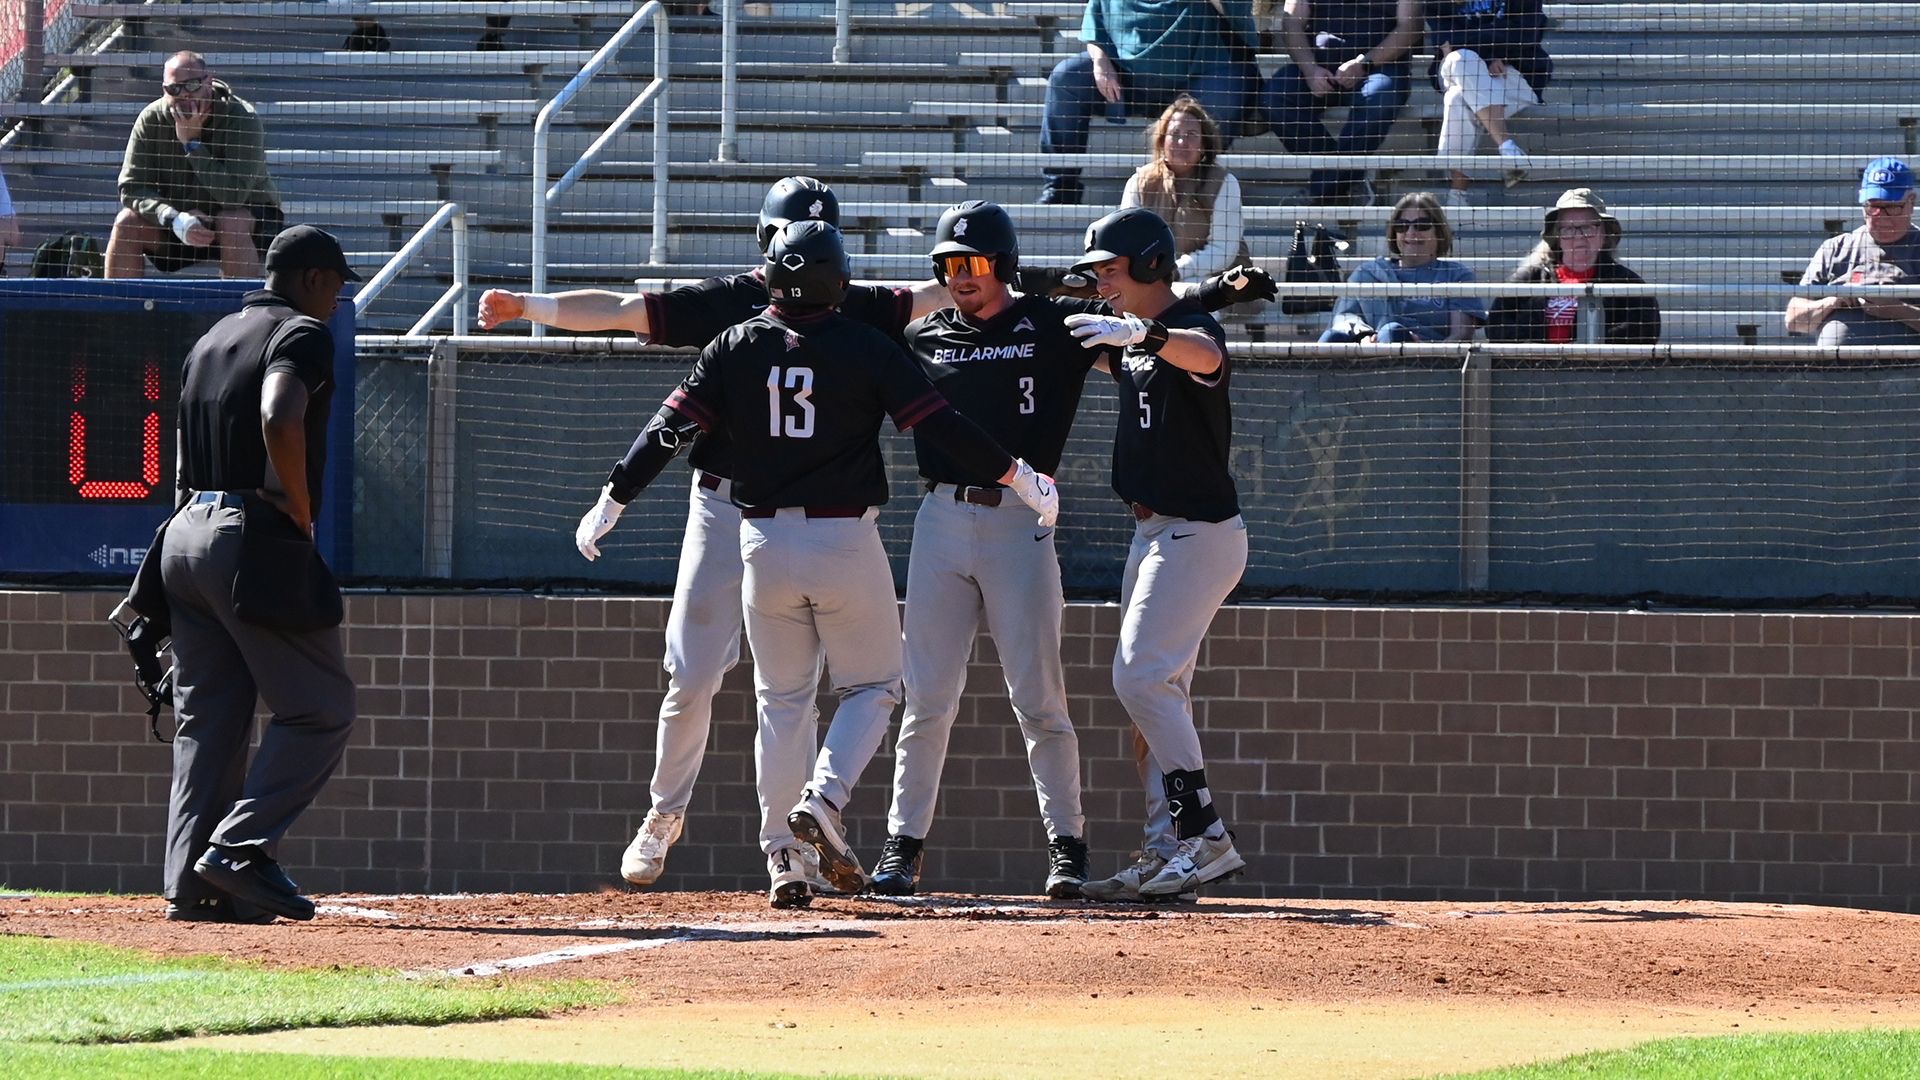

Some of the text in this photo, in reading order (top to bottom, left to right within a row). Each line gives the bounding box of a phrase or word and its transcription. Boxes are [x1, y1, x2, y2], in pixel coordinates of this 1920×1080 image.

[790, 287, 802, 298] 13
[931, 343, 1036, 364] BELLARMINE
[766, 365, 816, 439] 13
[1018, 376, 1035, 415] 3
[1138, 391, 1151, 429] 5
